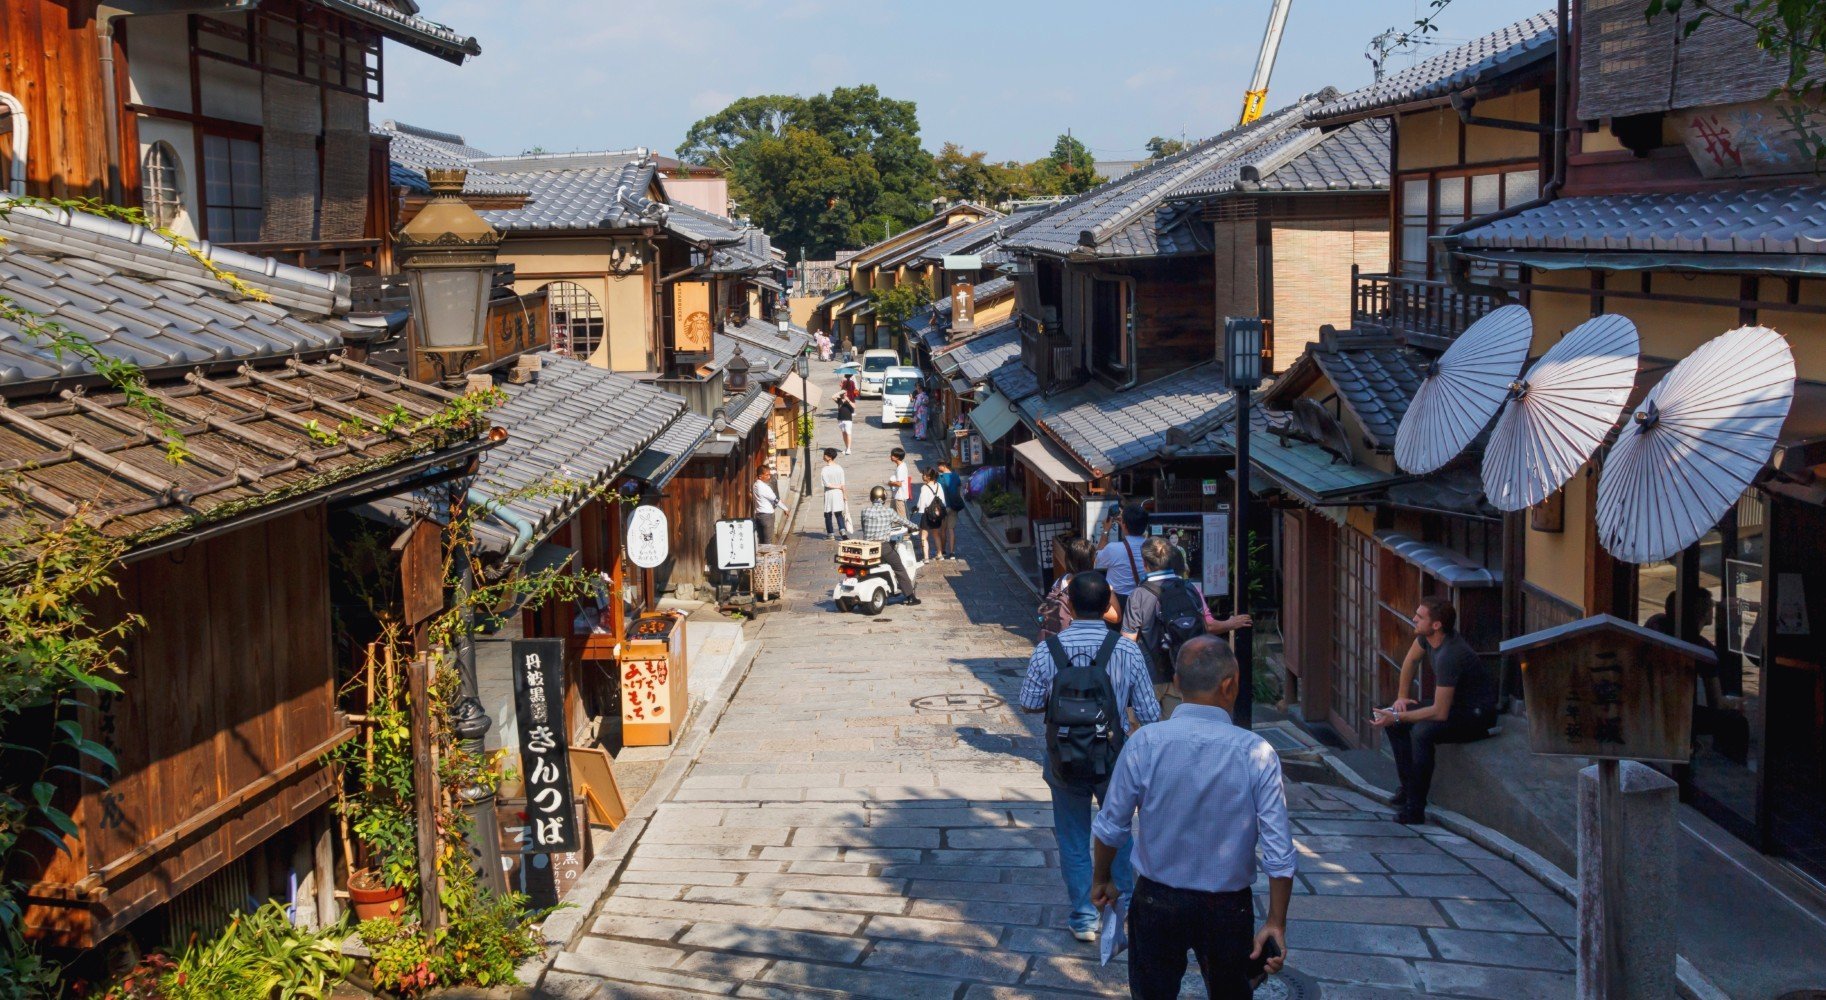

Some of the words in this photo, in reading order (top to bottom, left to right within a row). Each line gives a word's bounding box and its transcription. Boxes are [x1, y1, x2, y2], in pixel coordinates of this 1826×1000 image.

[625, 663, 647, 721] あげもち
[645, 660, 658, 704] もっちり
